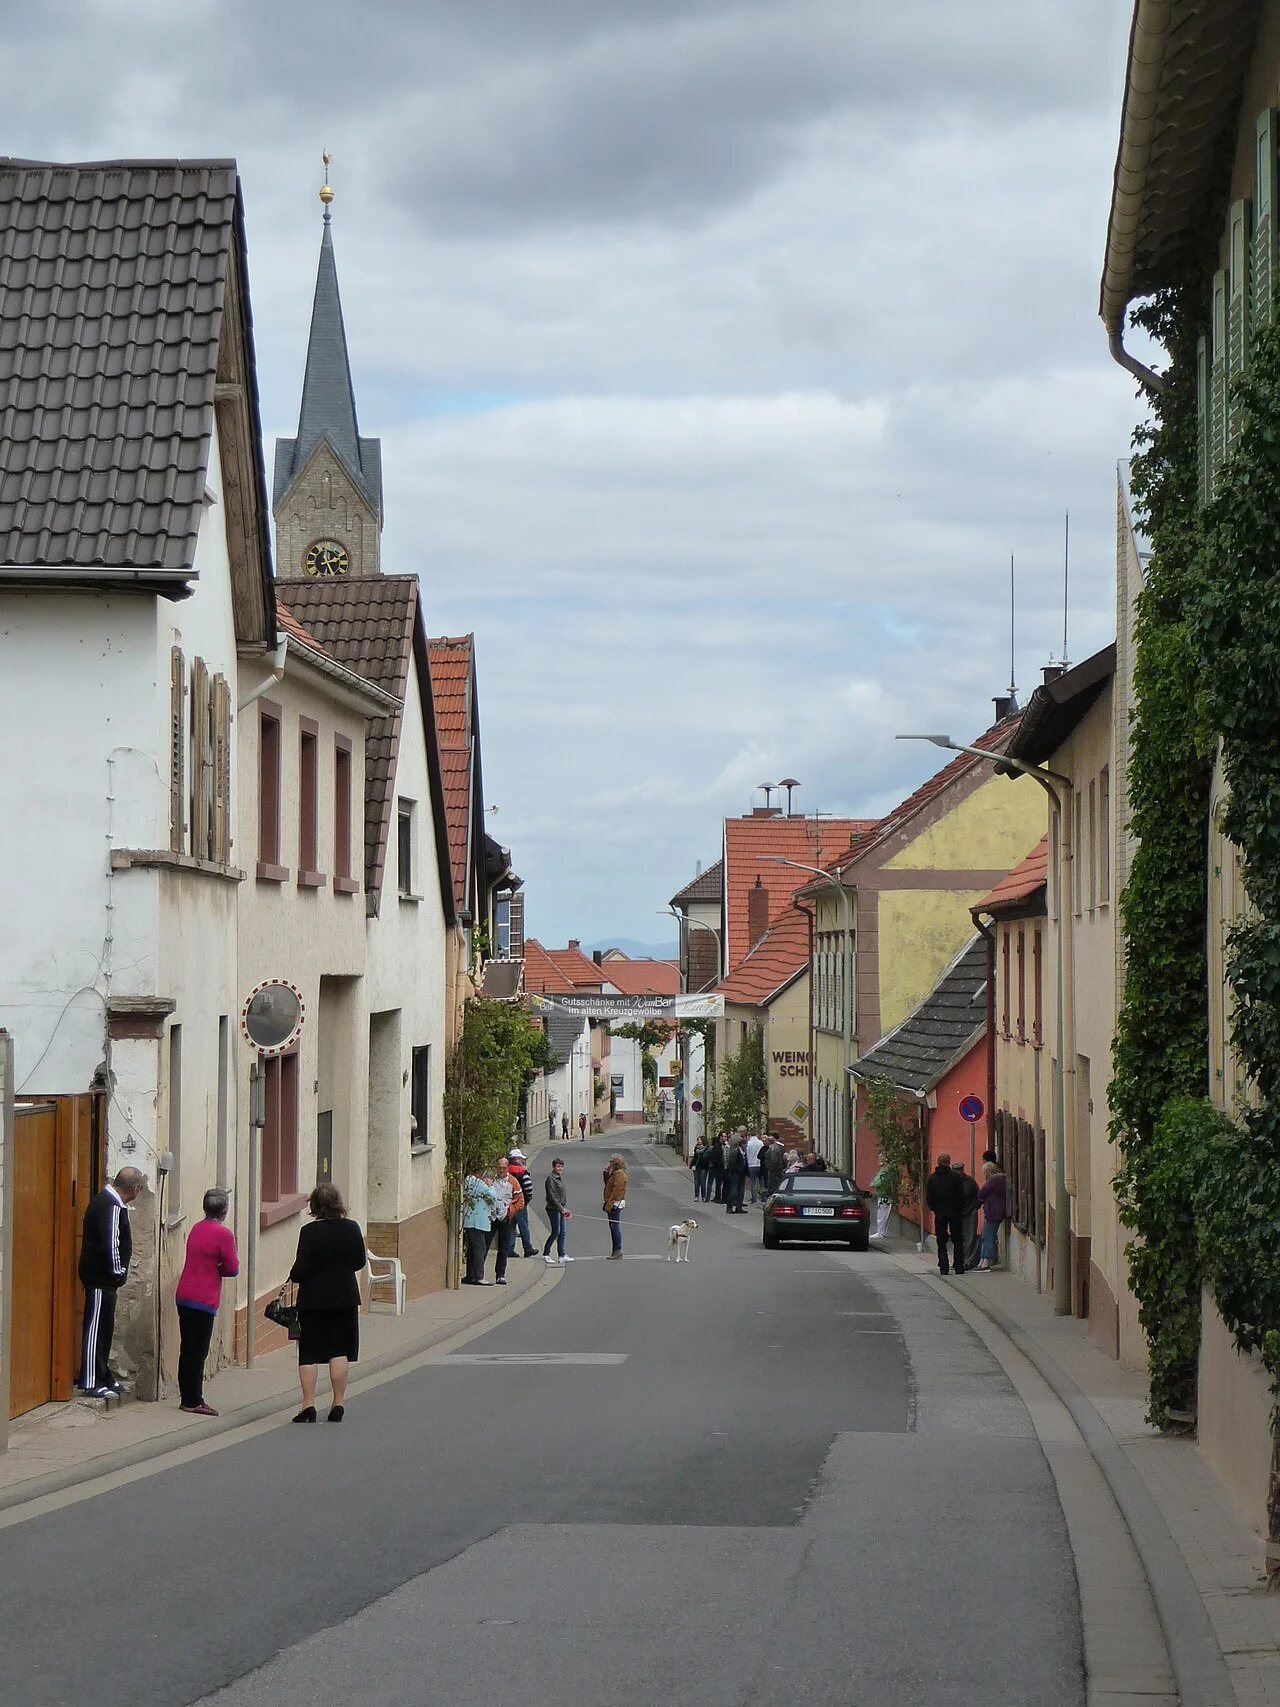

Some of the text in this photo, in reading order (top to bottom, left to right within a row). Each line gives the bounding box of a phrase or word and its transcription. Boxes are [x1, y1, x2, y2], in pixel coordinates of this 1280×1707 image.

[561, 997, 615, 1007] Gutsschänke
[617, 997, 631, 1007] mit
[568, 1006, 662, 1016] im alten Kreuzgewölbe
